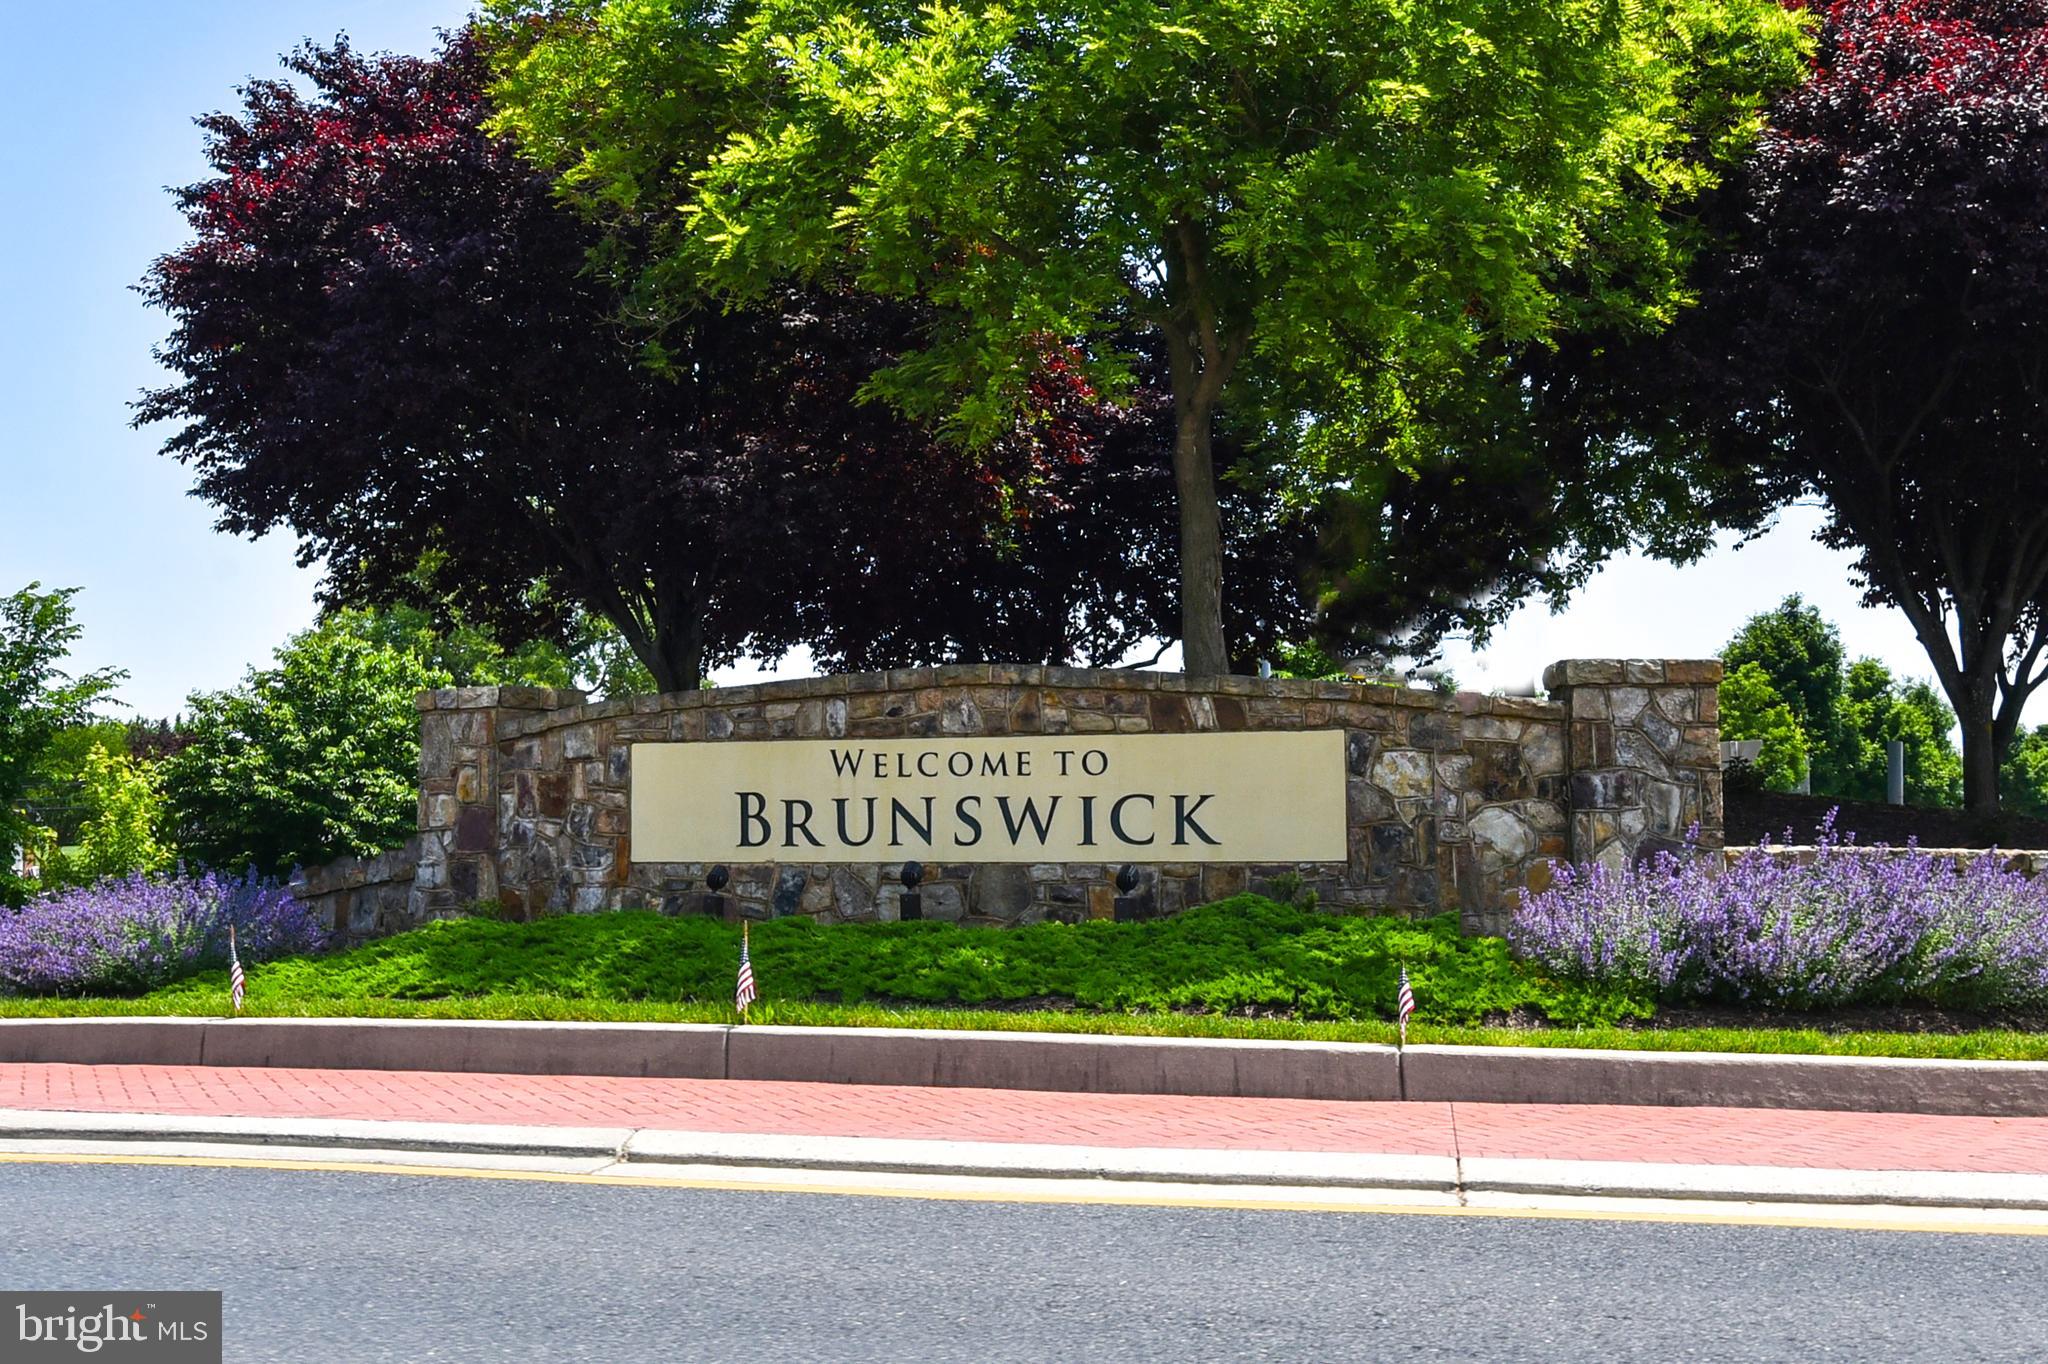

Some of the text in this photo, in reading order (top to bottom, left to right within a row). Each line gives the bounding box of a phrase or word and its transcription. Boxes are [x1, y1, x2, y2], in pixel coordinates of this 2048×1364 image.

[829, 748, 1109, 779] WELCOME TO
[734, 790, 1223, 848] BRUNSWICK
